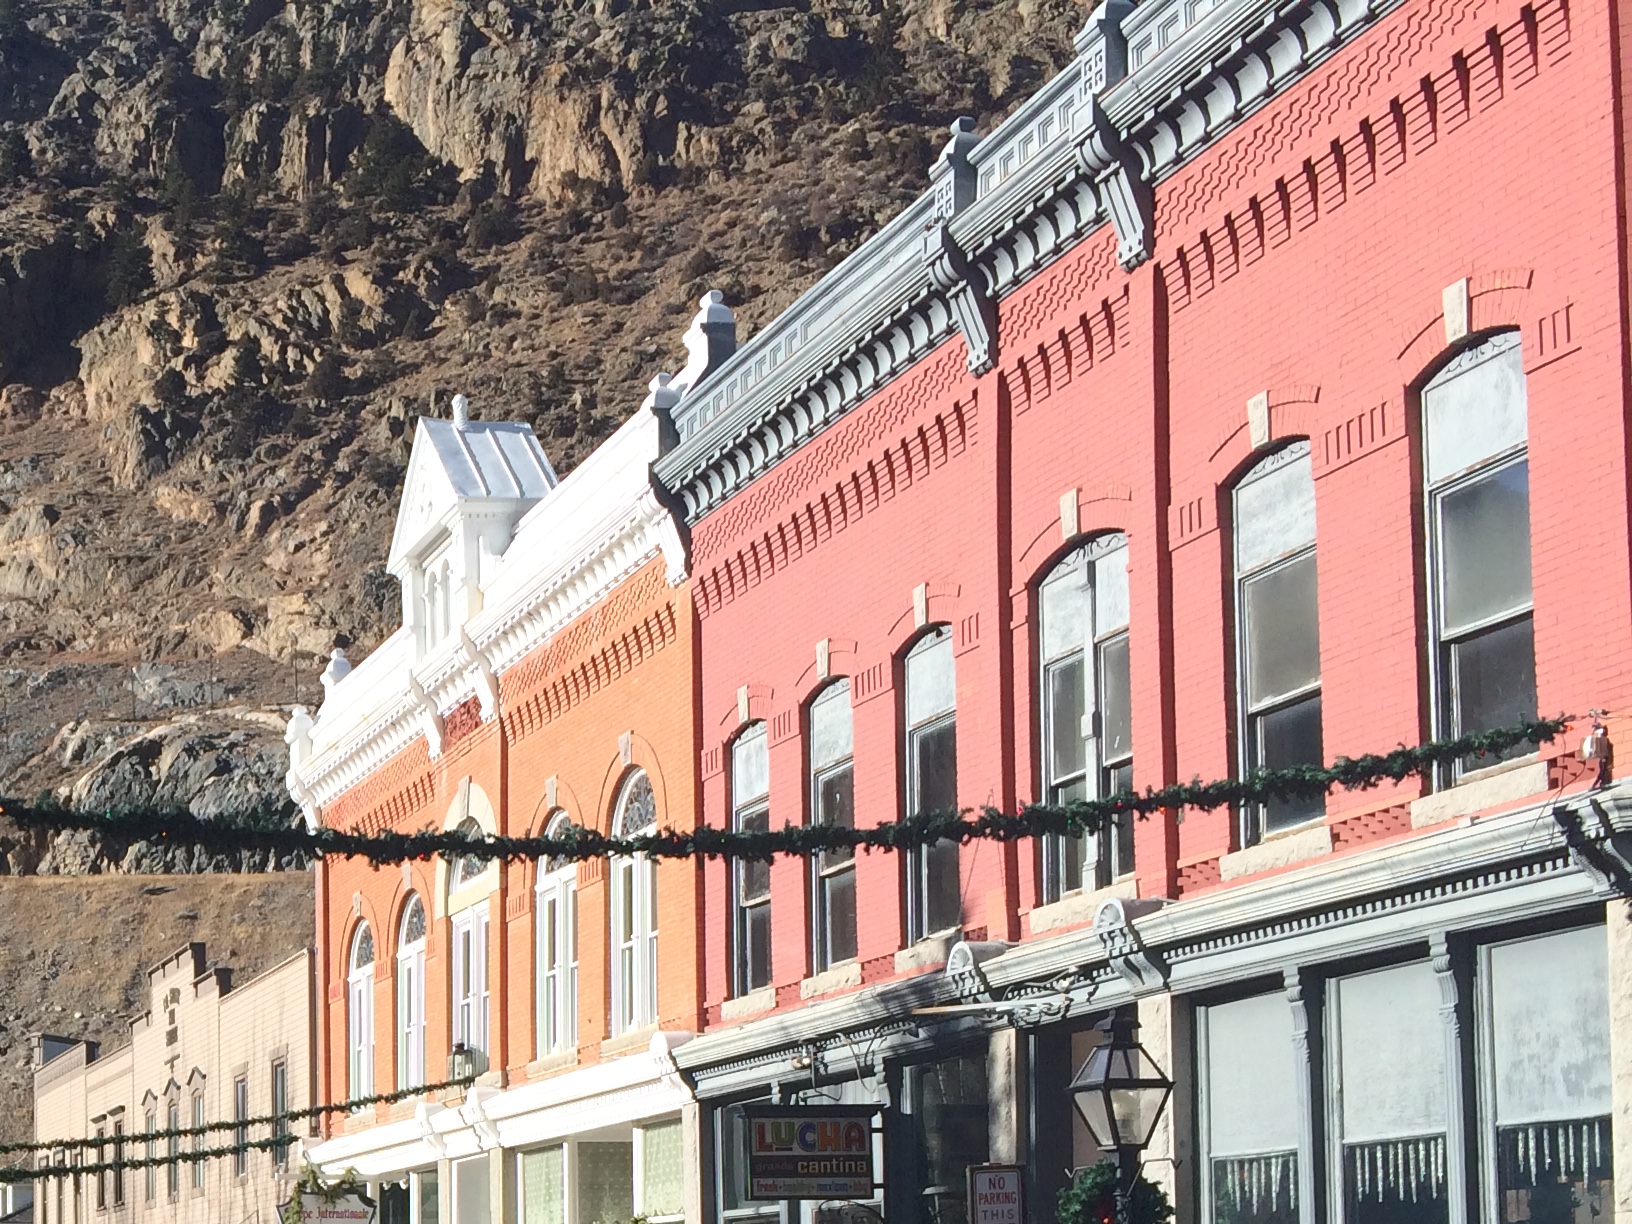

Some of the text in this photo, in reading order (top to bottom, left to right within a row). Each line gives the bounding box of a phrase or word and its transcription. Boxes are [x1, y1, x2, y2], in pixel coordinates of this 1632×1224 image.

[755, 1121, 867, 1153] LUCHA
[988, 1176, 1006, 1190] NO
[979, 1191, 1017, 1205] PARKING
[982, 1209, 1015, 1221] THIS
